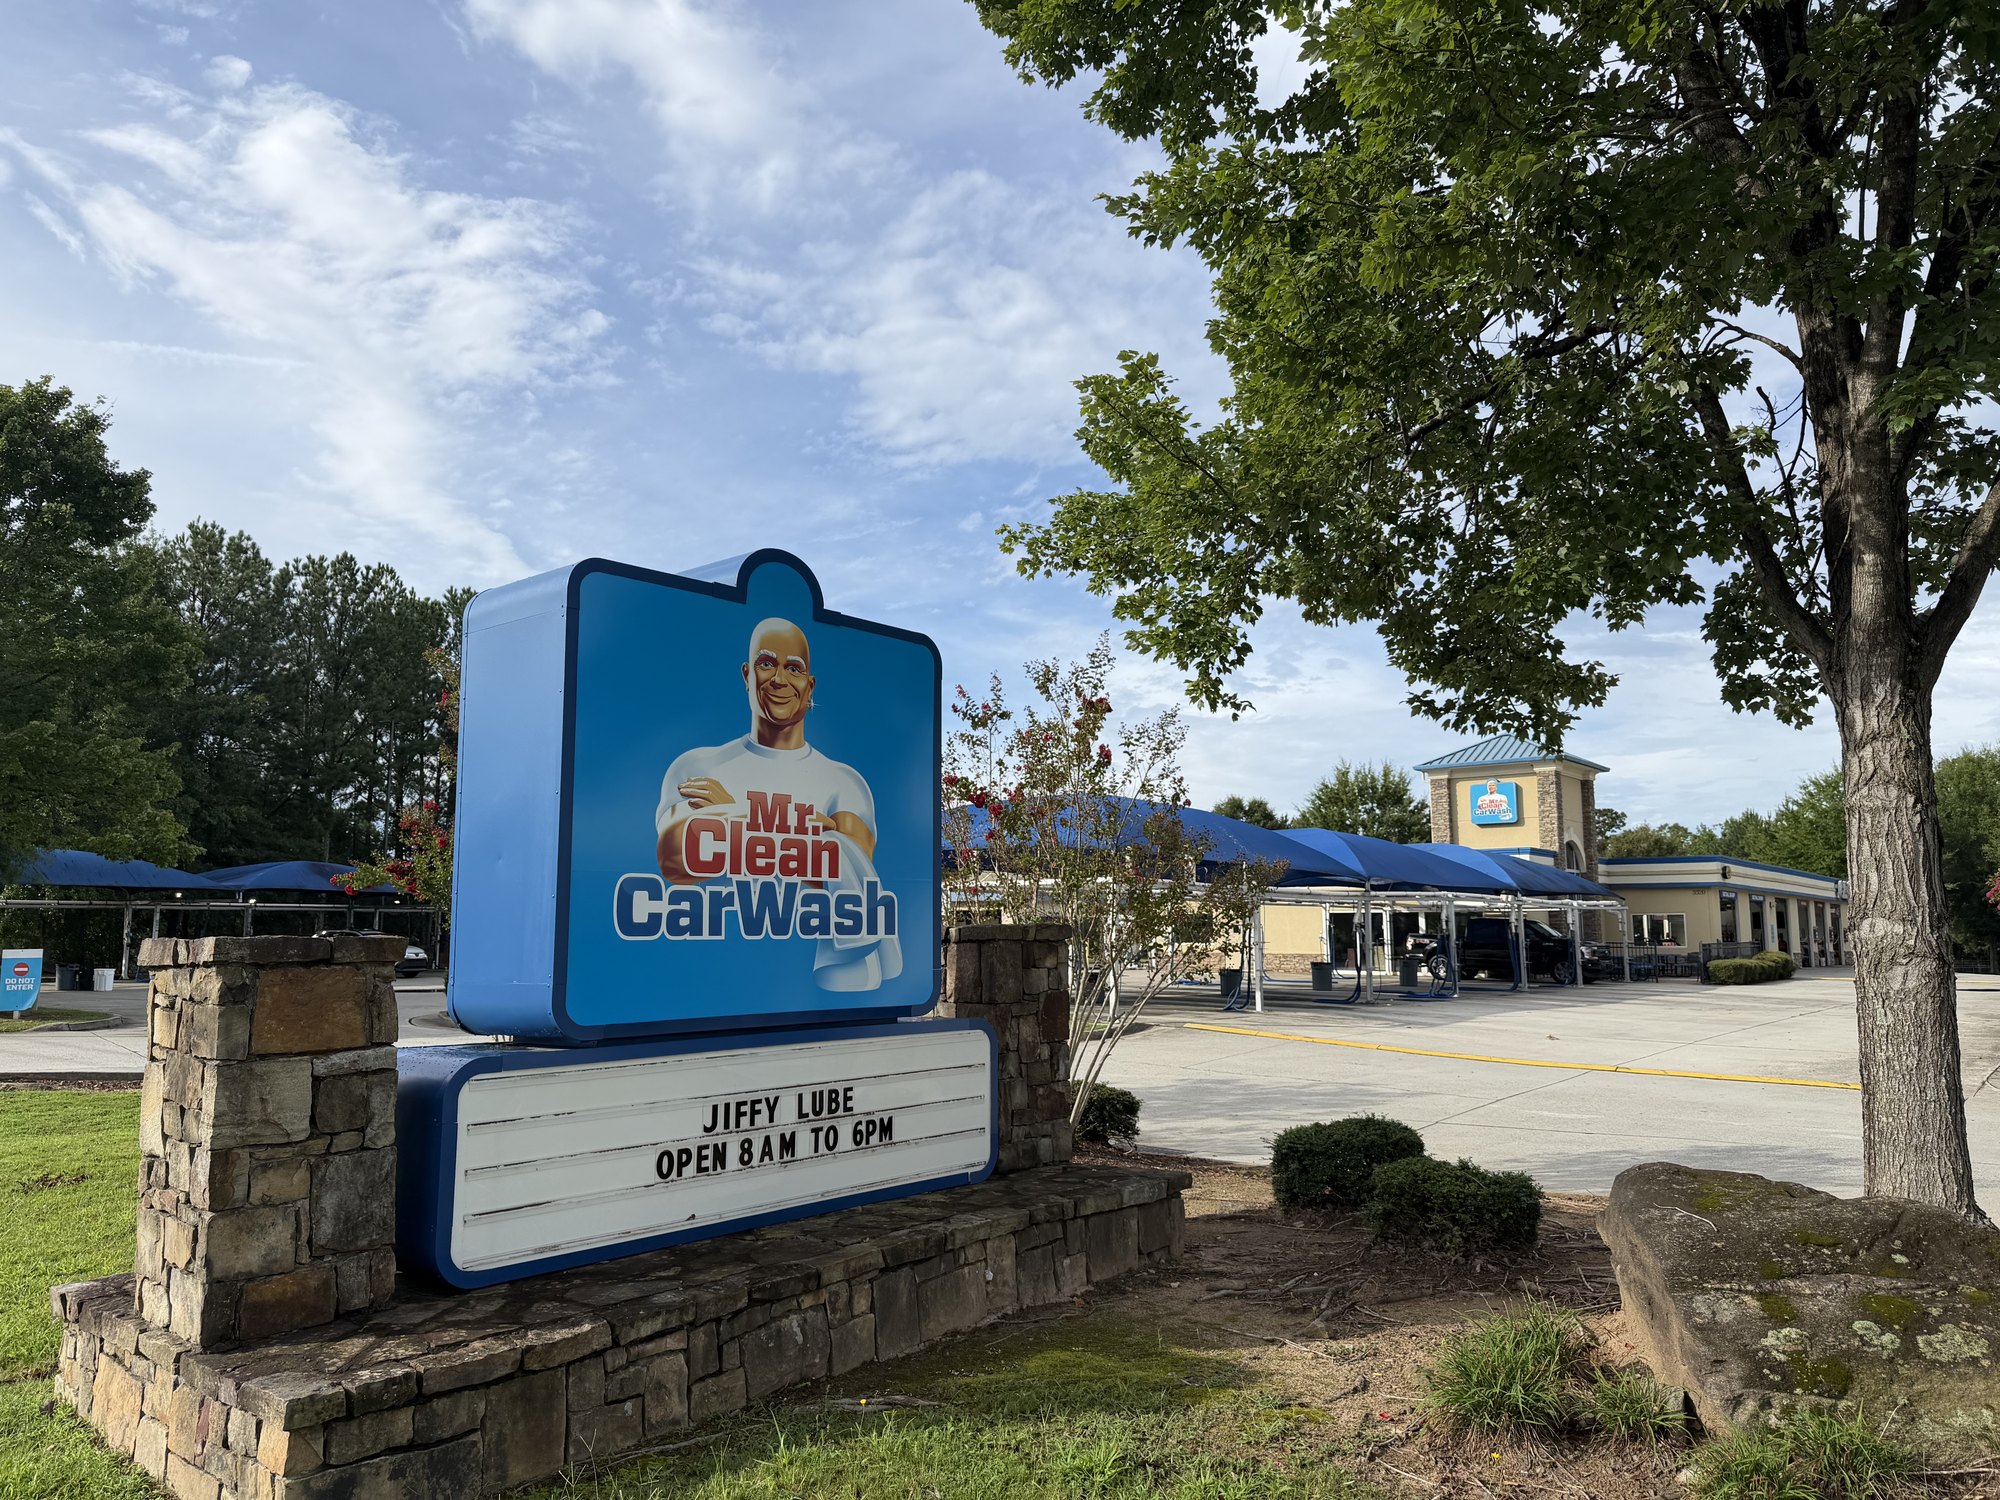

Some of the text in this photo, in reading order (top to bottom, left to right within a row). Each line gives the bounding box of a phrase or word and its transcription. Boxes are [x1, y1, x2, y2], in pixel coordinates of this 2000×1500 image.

[747, 790, 821, 836] Mr.
[1473, 807, 1512, 815] CarWash
[684, 817, 840, 879] Clean
[615, 876, 898, 938] CarWash
[703, 1087, 854, 1134] JIFFY LUBE
[656, 1116, 894, 1180] OPEN 8AM TO 6PM
